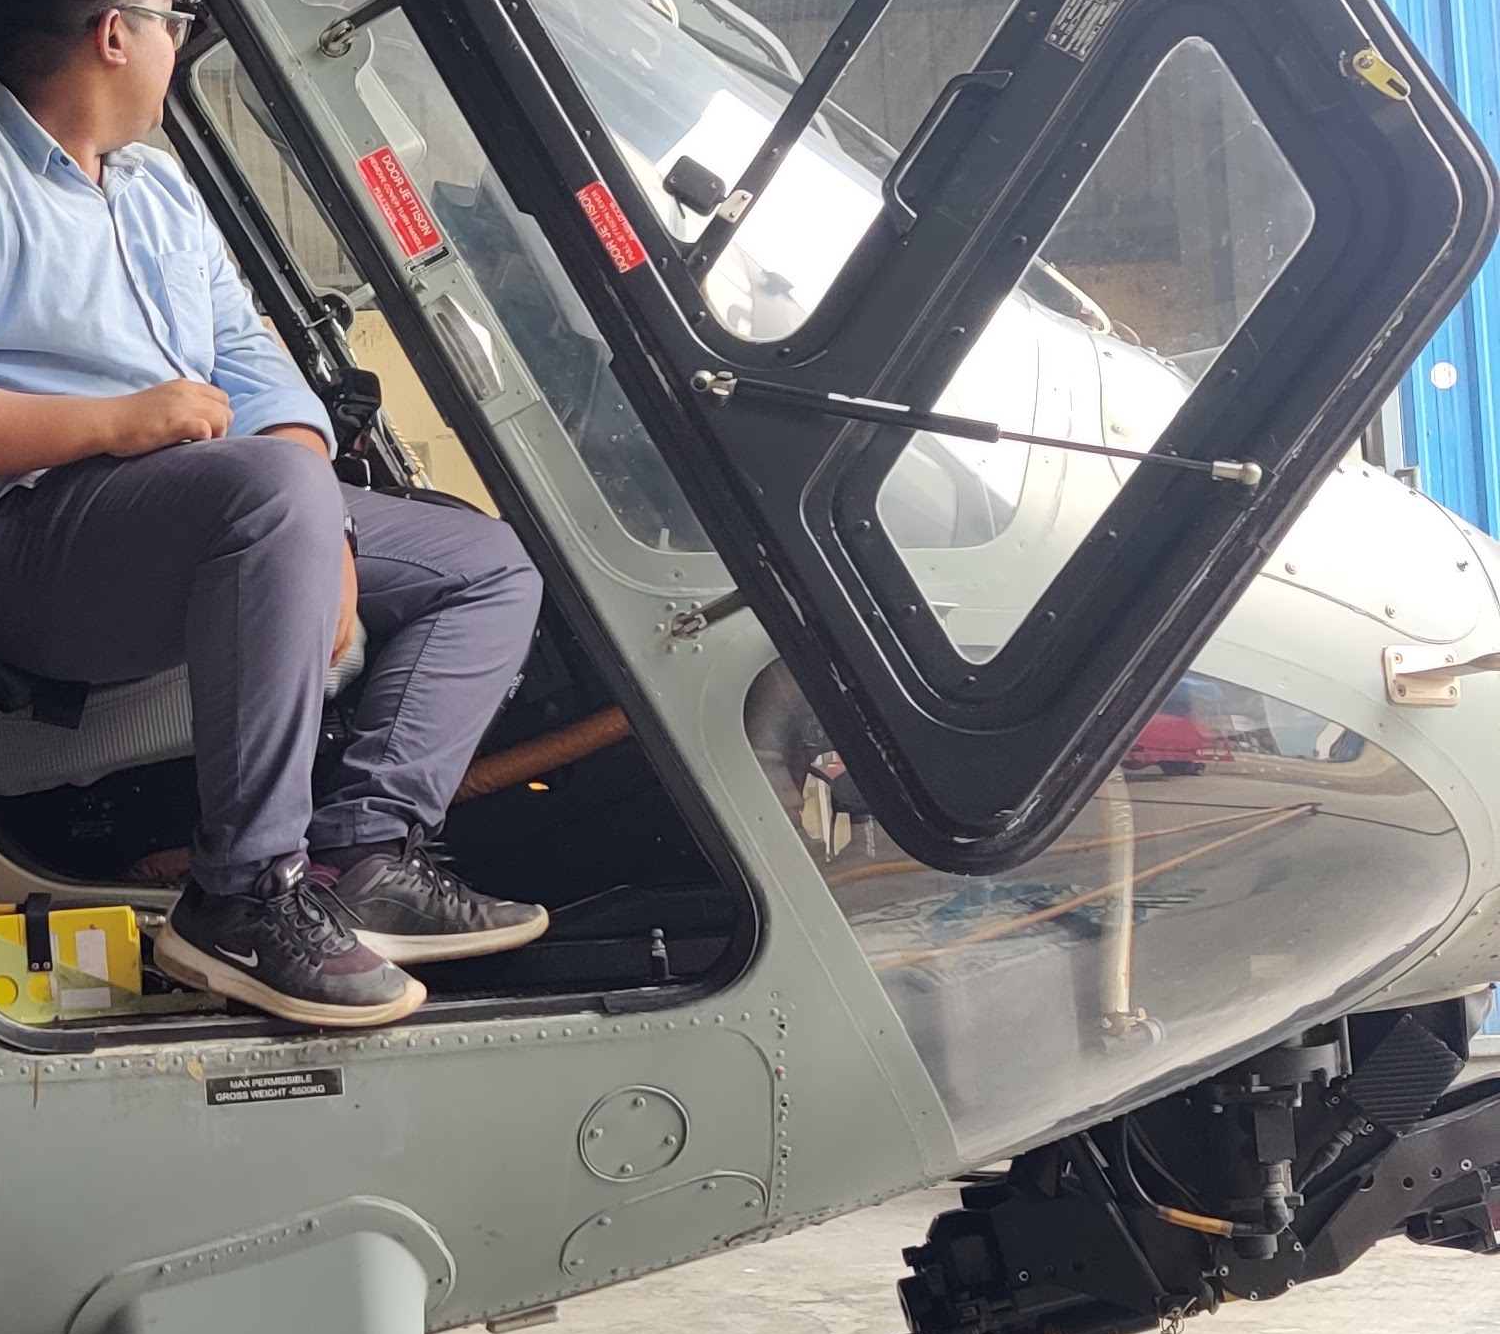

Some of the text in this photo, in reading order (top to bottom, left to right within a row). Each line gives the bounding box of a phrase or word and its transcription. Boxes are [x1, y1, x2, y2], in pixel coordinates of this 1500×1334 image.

[382, 154, 404, 188] DOOR
[398, 187, 432, 237] JETTISON
[576, 189, 631, 273] DOOR JETTISON
[215, 1091, 249, 1102] GROSS
[250, 1088, 287, 1099] WEIGHT
[230, 1074, 312, 1089] MAX PERMISSIBLE
